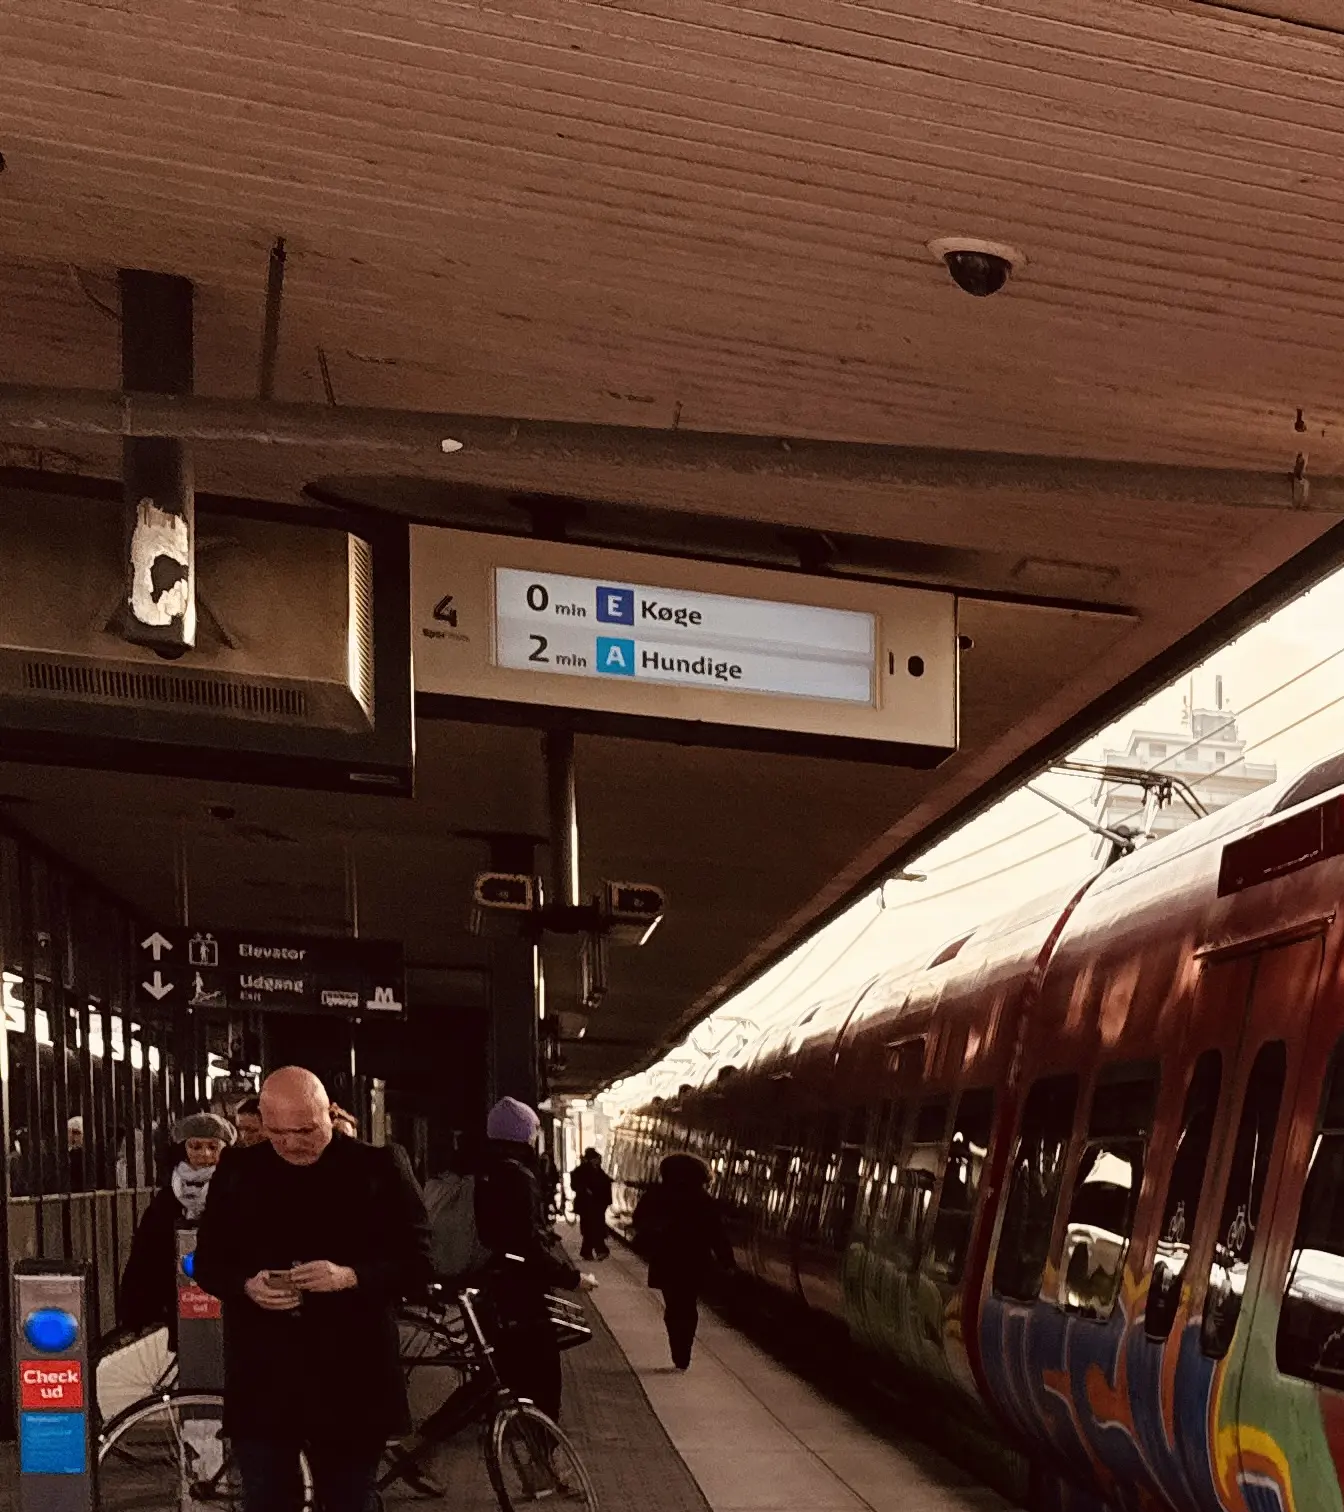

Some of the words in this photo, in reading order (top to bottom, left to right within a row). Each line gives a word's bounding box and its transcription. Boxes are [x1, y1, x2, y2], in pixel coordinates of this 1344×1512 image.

[433, 594, 458, 627] 4
[526, 584, 549, 612] 0
[555, 602, 587, 618] min
[607, 595, 623, 617] E
[641, 600, 702, 627] Køge
[528, 634, 549, 663] 2
[556, 653, 587, 668] min
[606, 645, 626, 668] A
[641, 650, 742, 681] Hundige
[239, 943, 307, 960] Elevator
[240, 974, 304, 994] Udgang
[23, 1369, 79, 1385] Check
[40, 1385, 64, 1399] ud
